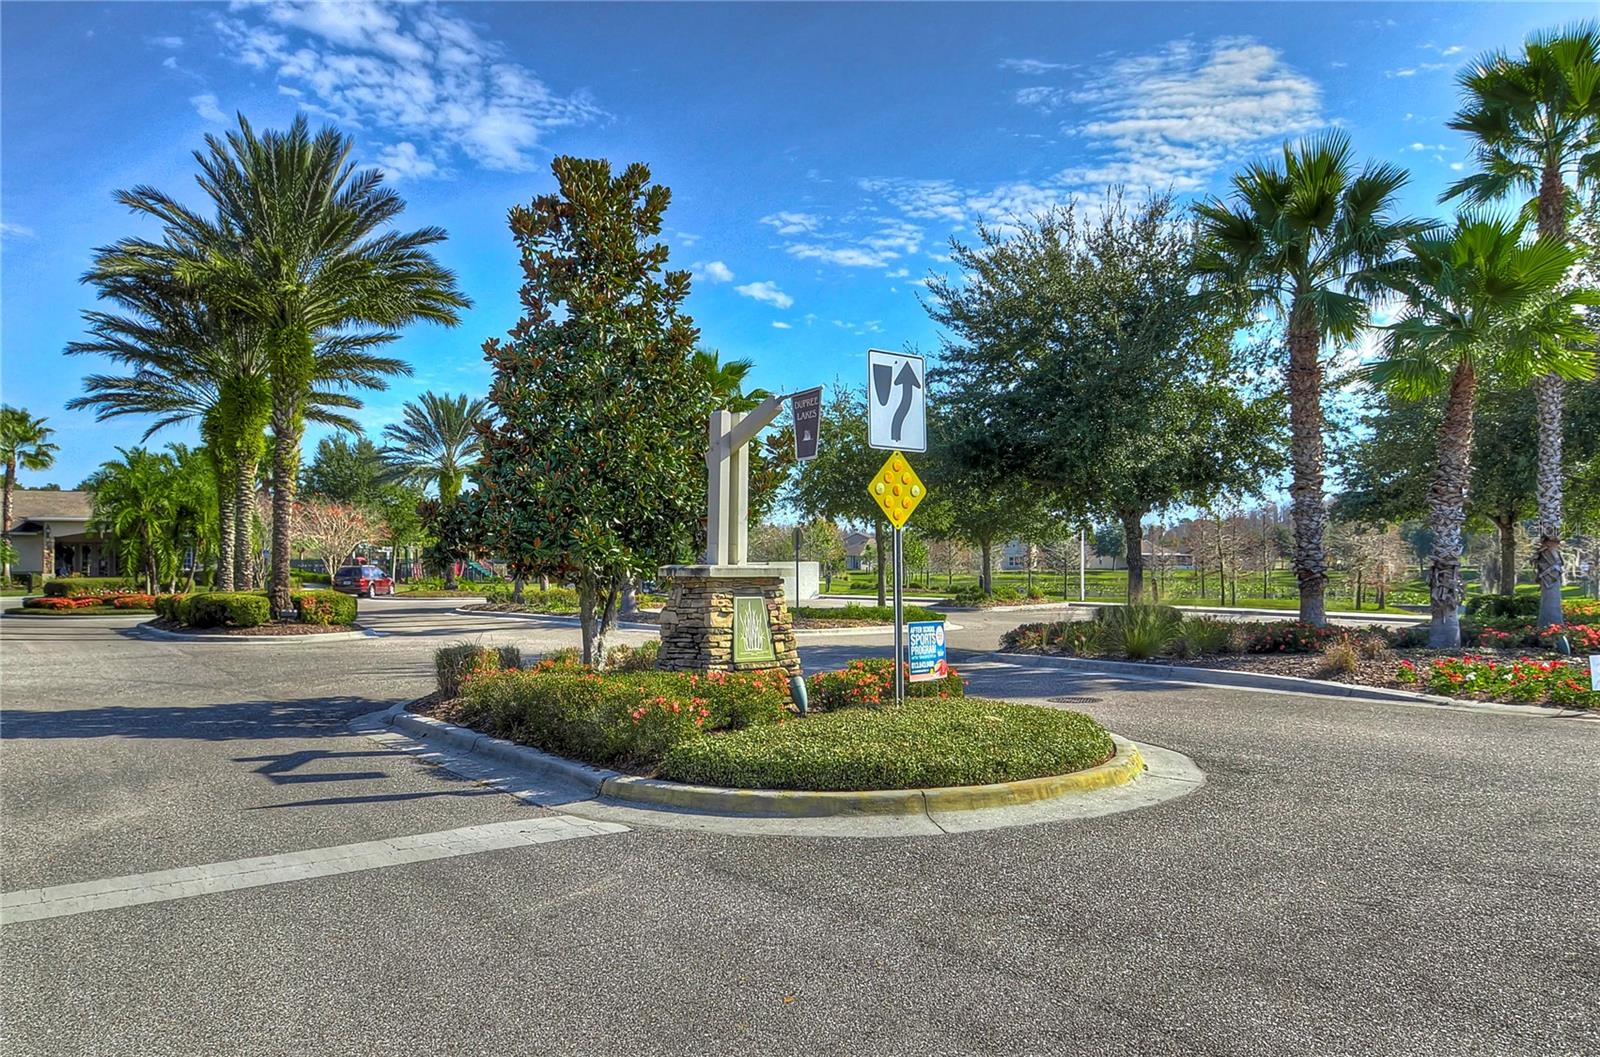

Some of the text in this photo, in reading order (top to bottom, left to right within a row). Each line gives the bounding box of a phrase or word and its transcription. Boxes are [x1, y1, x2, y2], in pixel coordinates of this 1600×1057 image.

[795, 397, 818, 409] DUPREE
[797, 409, 817, 421] LAKES
[910, 626, 922, 634] AFTER
[910, 633, 936, 646] SPORTS
[911, 645, 937, 656] PROGRAM
